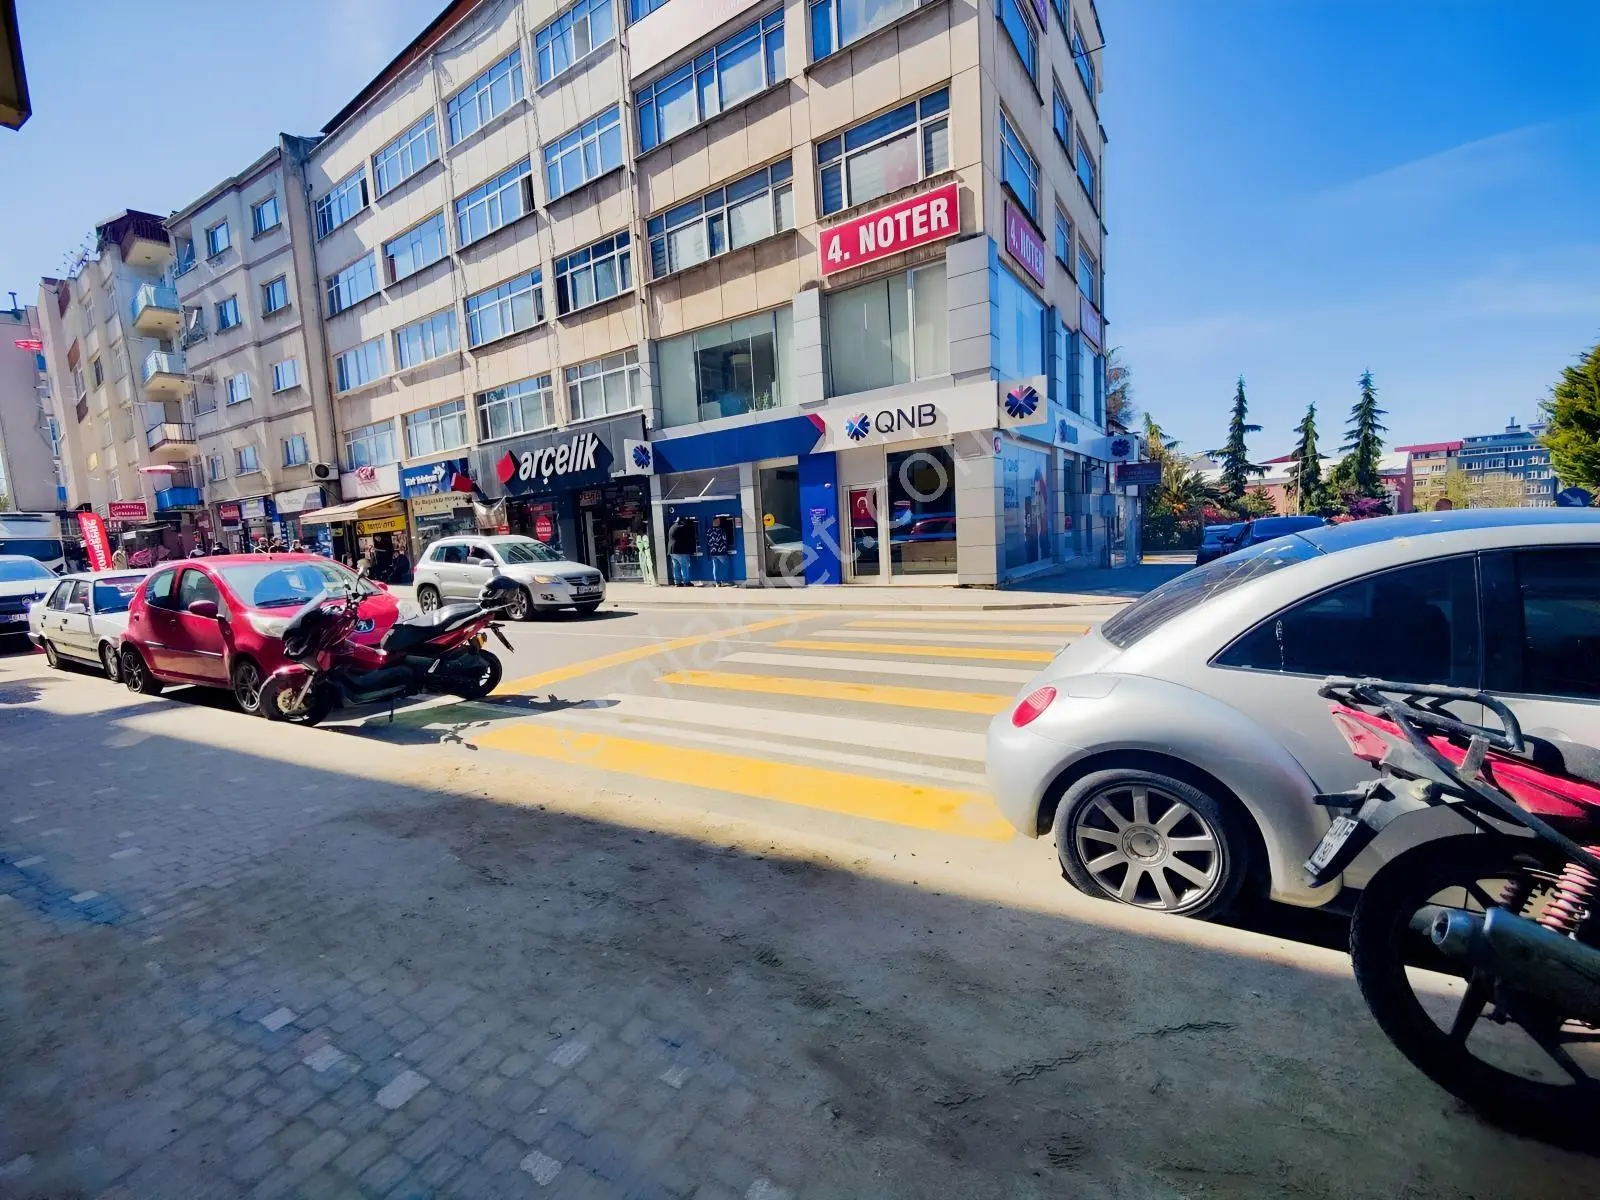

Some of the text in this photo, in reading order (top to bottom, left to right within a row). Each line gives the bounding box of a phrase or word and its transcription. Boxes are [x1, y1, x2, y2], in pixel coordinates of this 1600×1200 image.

[827, 197, 950, 263] 4. NOTER
[1010, 216, 1044, 278] 4. NOTER
[875, 403, 937, 434] QNB
[519, 432, 599, 485] arçelik
